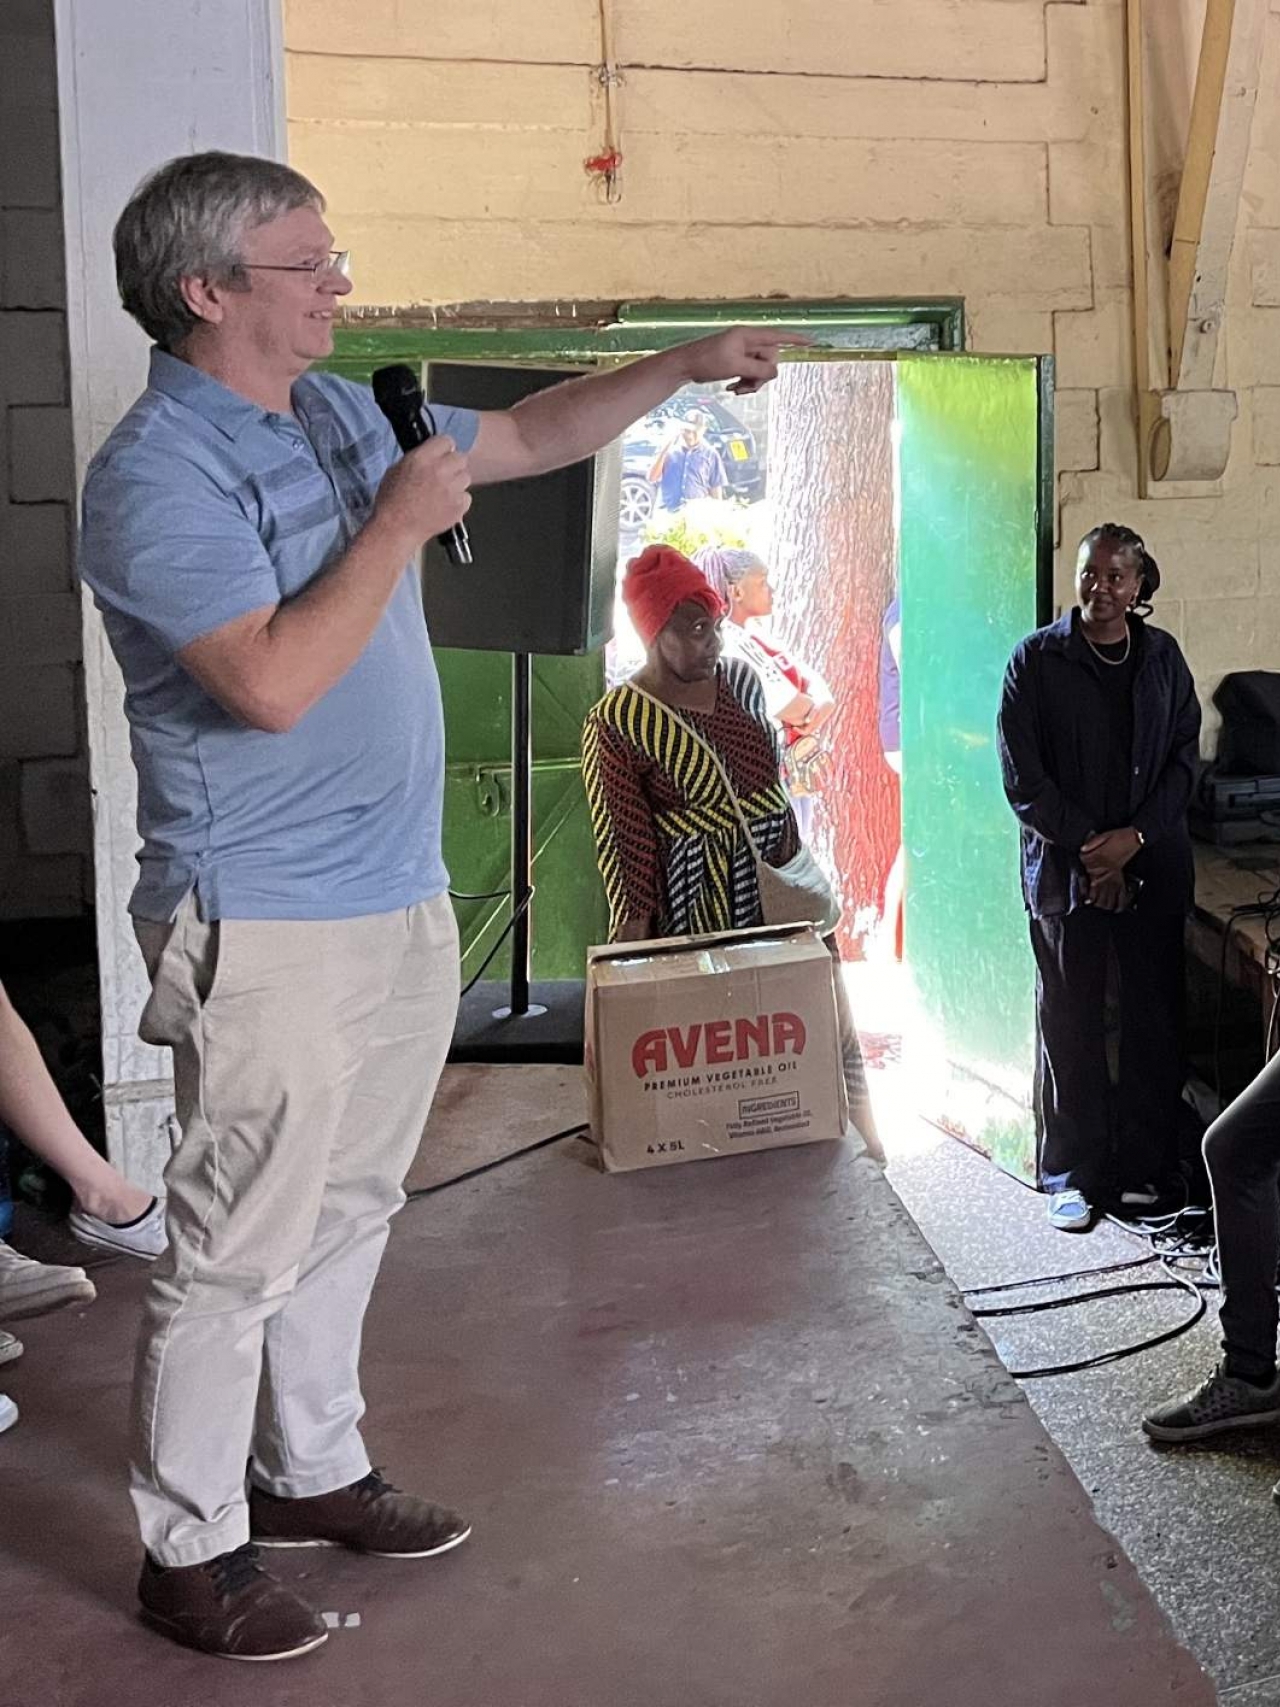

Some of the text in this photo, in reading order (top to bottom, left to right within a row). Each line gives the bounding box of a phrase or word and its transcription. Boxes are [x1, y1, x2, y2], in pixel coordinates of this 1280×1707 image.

[631, 1012, 806, 1079] AVENA
[644, 1061, 797, 1091] PREMIUM VEGETABLE OIL
[667, 1083, 745, 1099] CHOLESTEROL
